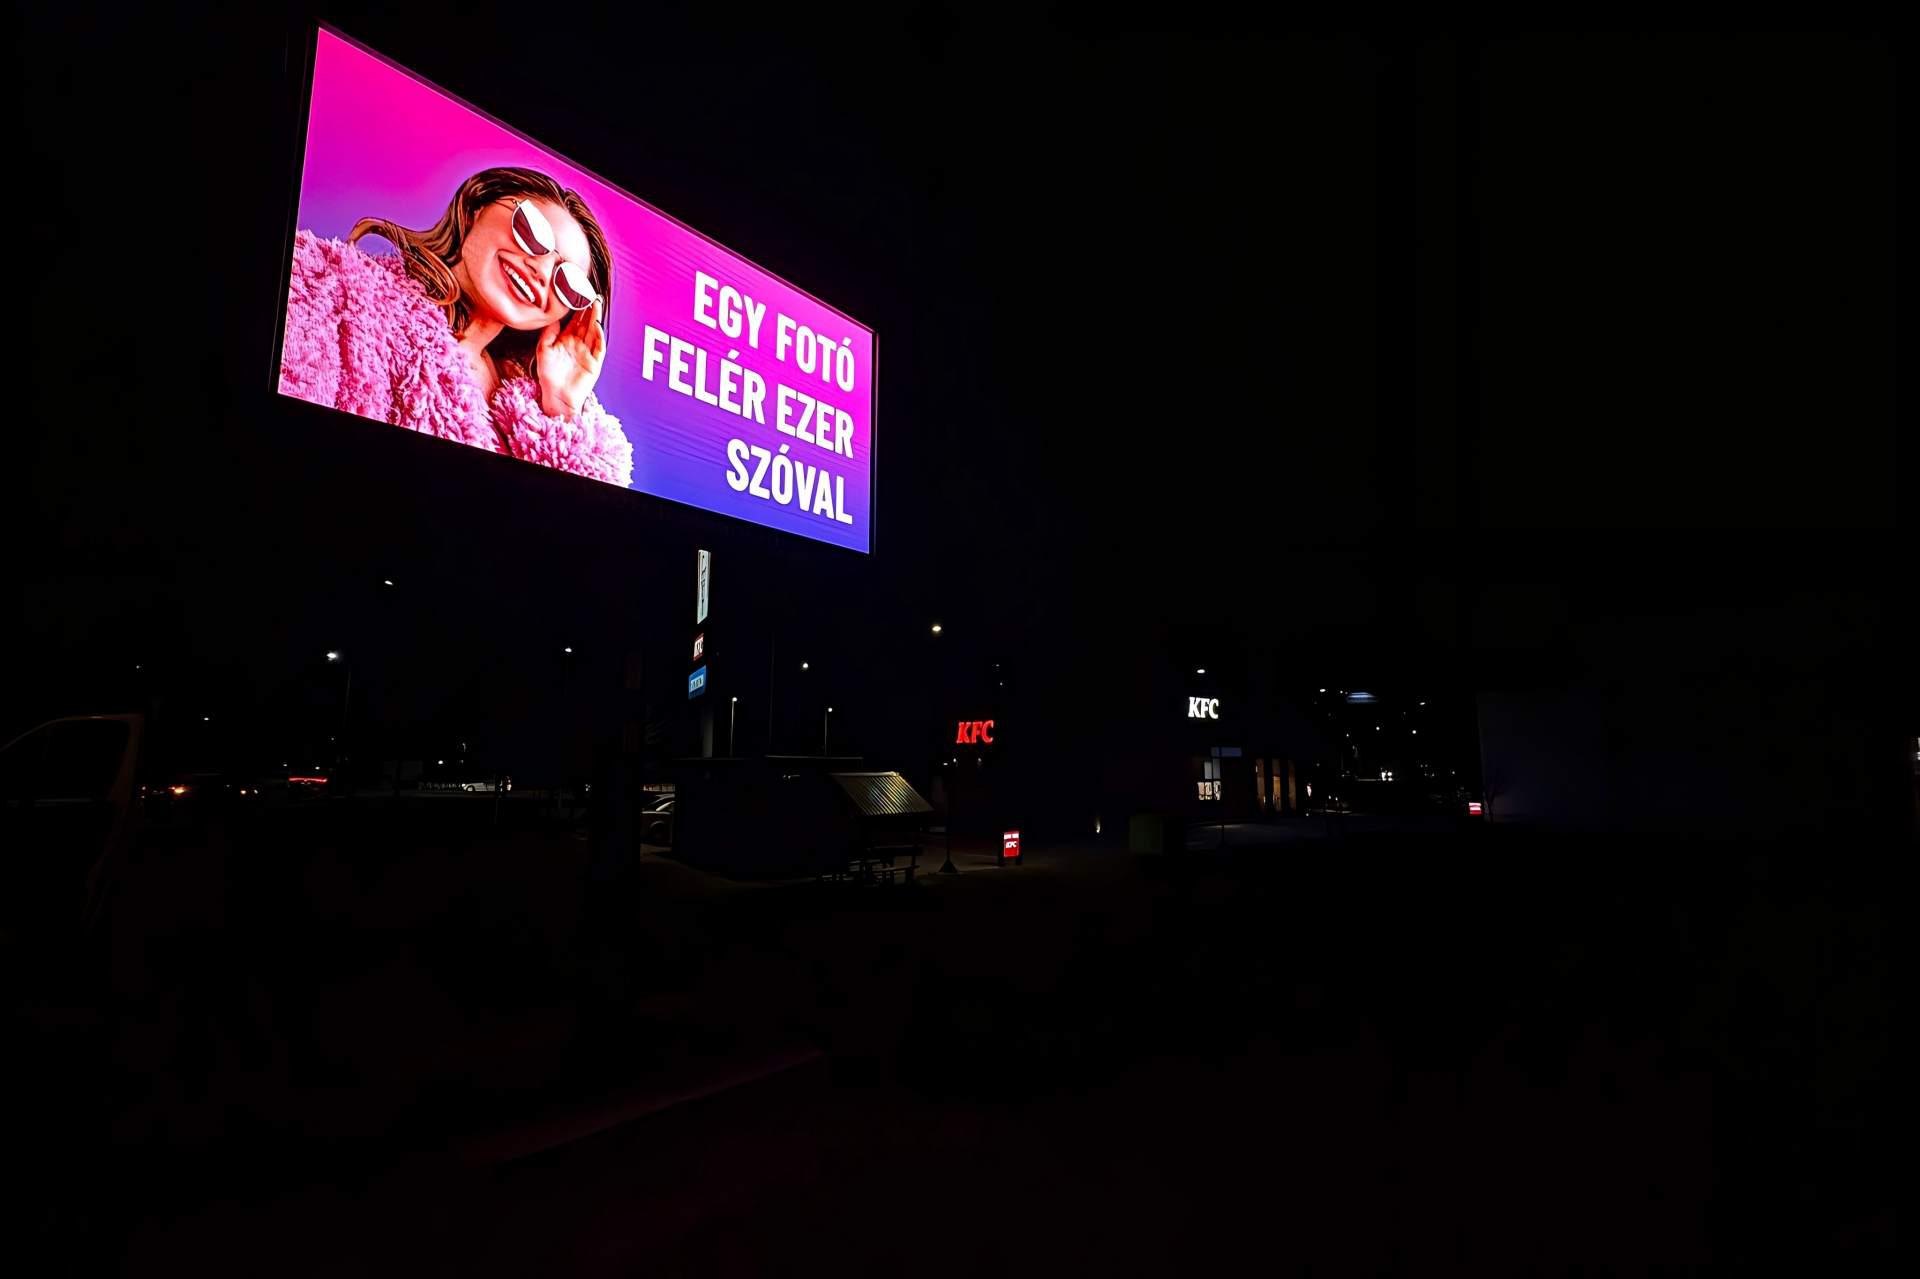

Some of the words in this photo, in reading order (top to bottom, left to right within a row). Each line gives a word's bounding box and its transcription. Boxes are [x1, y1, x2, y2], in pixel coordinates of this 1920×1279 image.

[693, 270, 767, 349] EGY
[776, 313, 855, 392] FOTÓ
[642, 325, 766, 425] FELÉR
[776, 383, 854, 459] EZER
[726, 438, 853, 525] SZÓVAL
[956, 719, 995, 744] KFC
[1188, 696, 1219, 719] KFC
